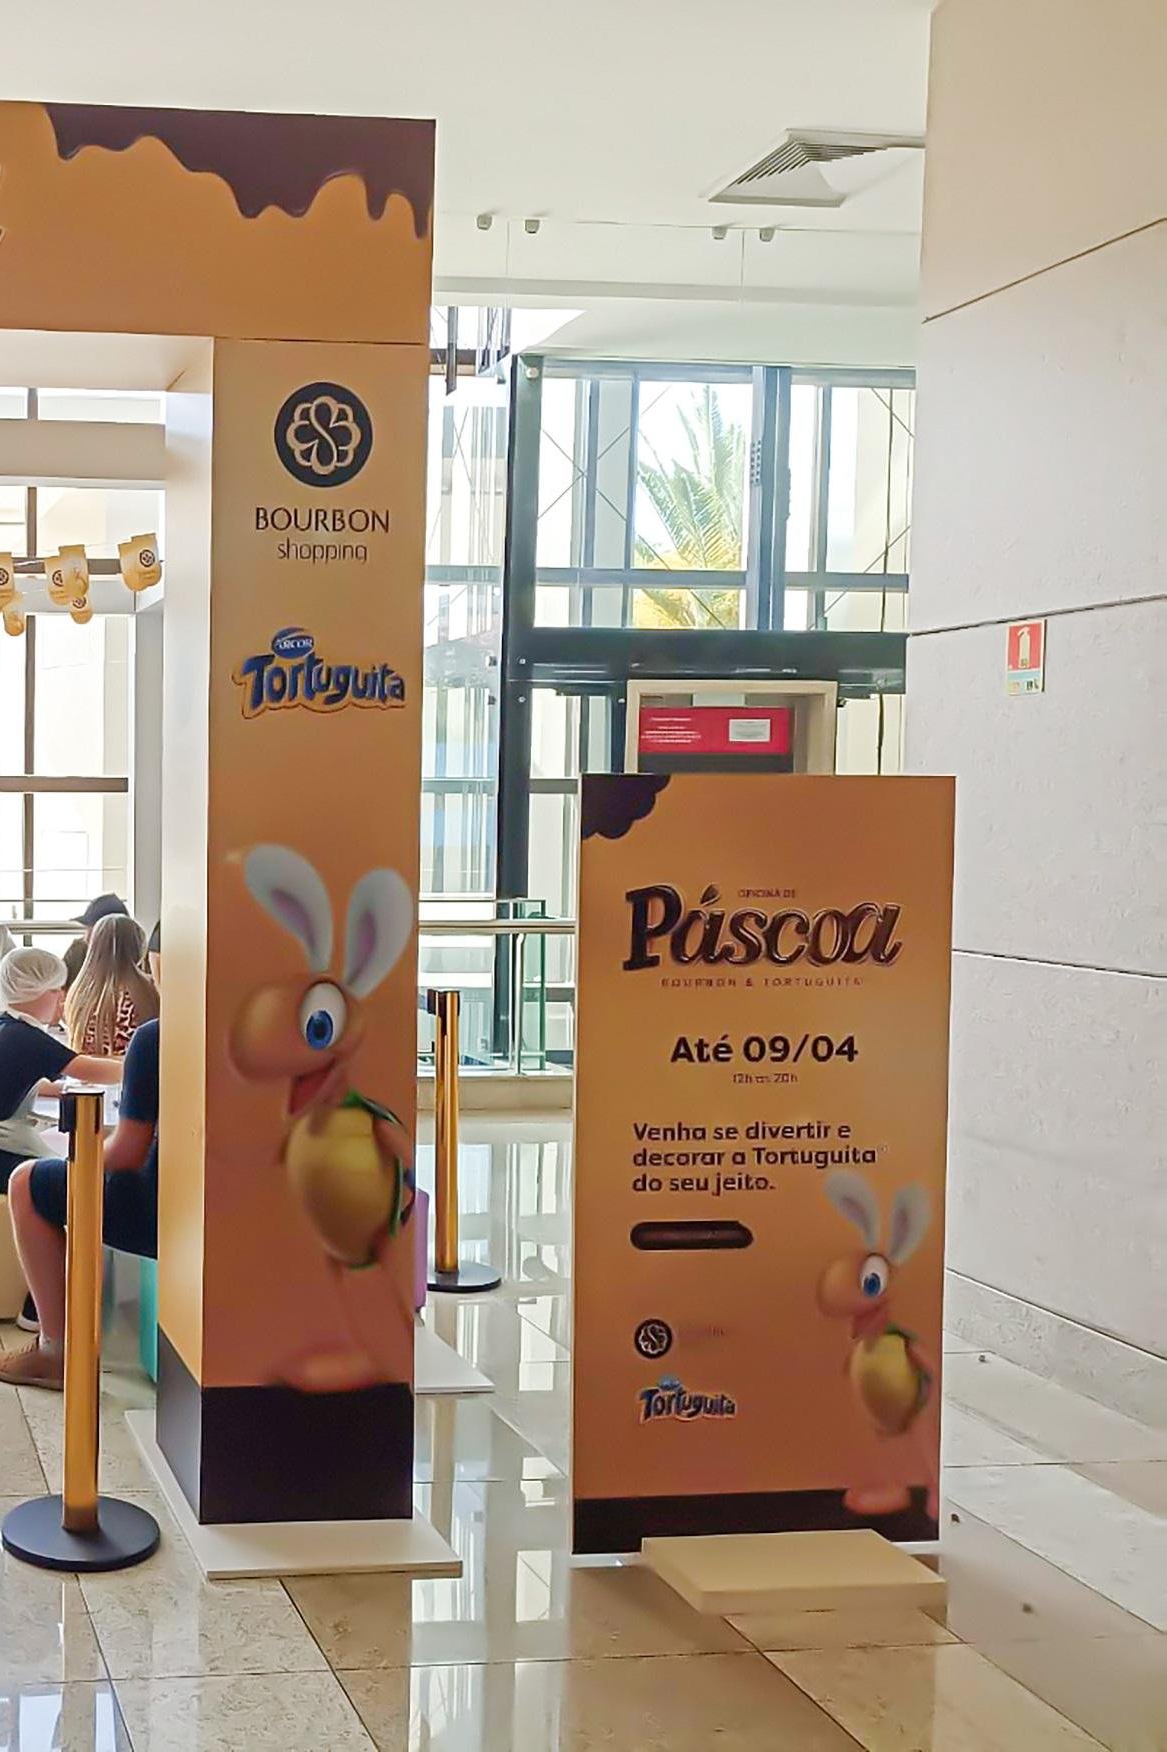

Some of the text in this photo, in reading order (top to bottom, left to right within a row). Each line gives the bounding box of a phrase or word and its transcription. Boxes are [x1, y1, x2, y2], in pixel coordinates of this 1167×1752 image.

[255, 506, 390, 533] BOURBON
[277, 538, 368, 564] shopping
[241, 652, 406, 711] Tortuguita
[622, 882, 903, 971] Páscoa
[670, 1033, 859, 1063] Até 09/04
[633, 1121, 851, 1141] Venha se divertir e
[632, 1148, 725, 1167] decorar
[732, 1152, 746, 1165] a
[632, 1172, 776, 1196] do seu jeito.
[639, 1387, 736, 1421] Tortuguita
